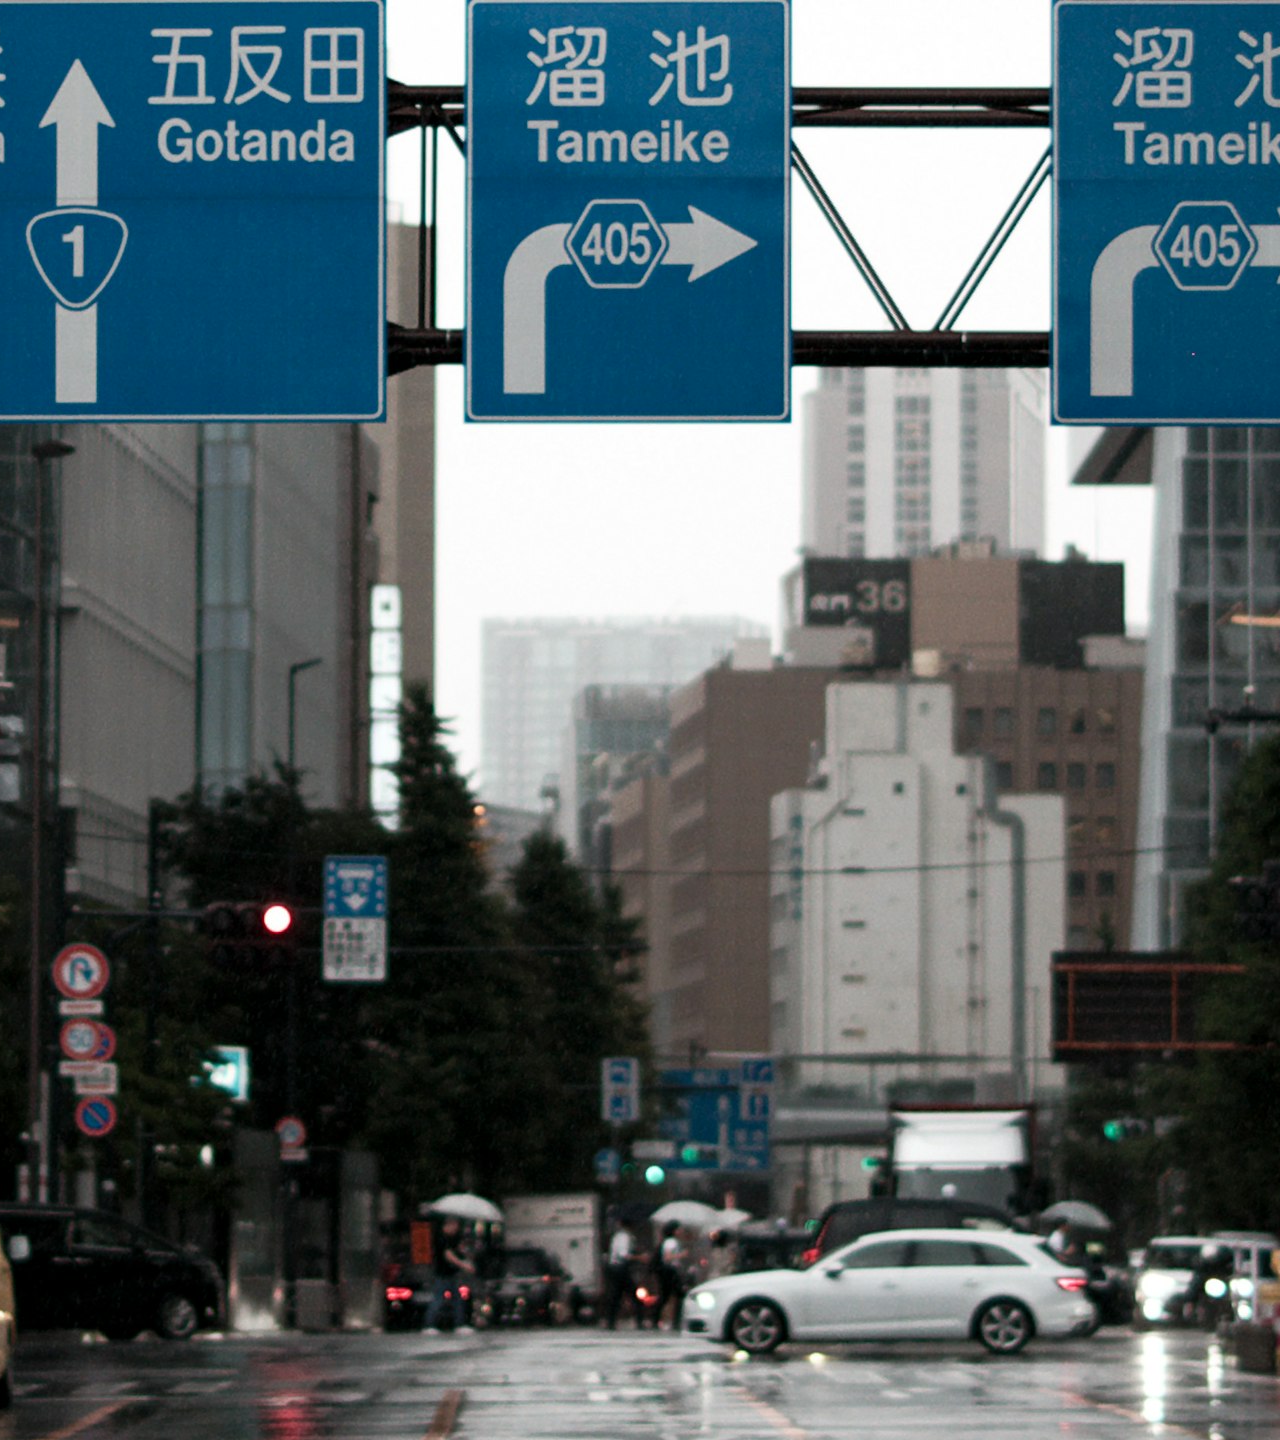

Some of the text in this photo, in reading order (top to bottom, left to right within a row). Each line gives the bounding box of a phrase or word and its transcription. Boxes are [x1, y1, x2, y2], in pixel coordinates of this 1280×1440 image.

[147, 25, 365, 105] 五反田
[526, 25, 733, 107] 溜池
[157, 117, 355, 163] Gotanda
[527, 119, 730, 163] Tameike
[62, 225, 85, 277] 1
[581, 222, 652, 265] 405
[1169, 224, 1241, 268] 405
[856, 580, 907, 613] 36
